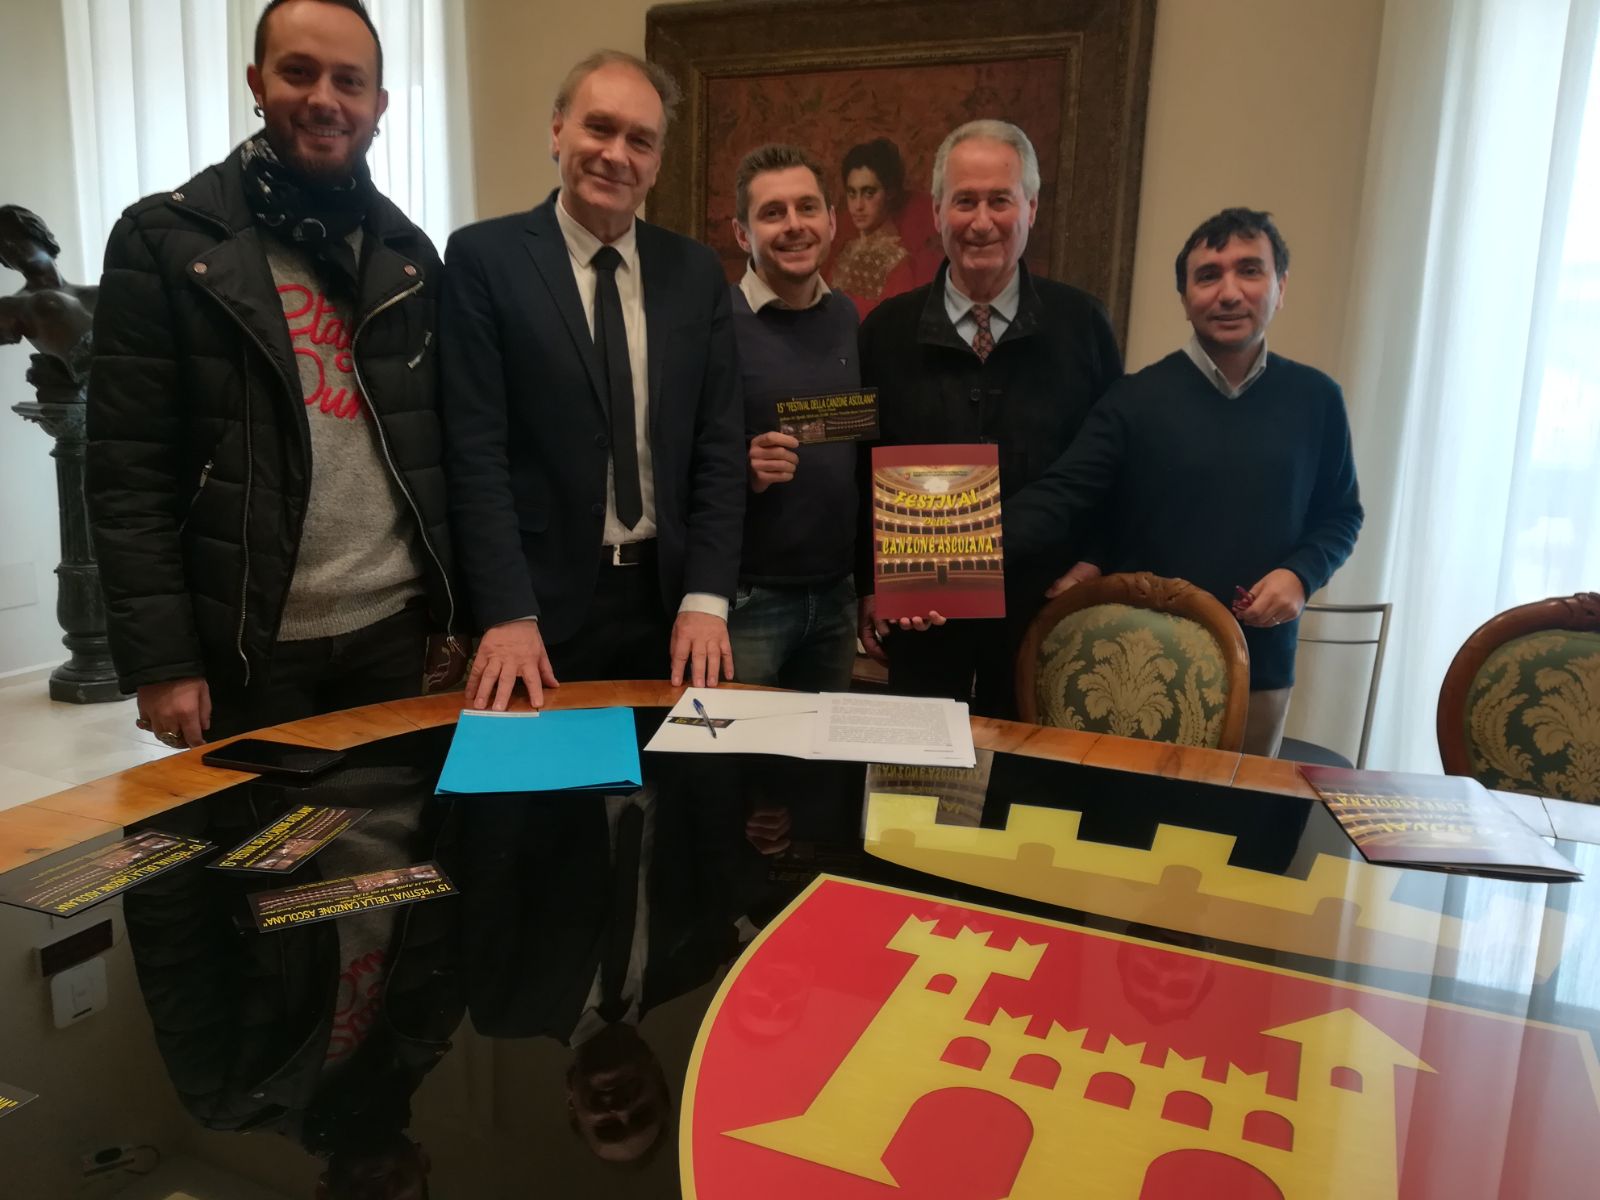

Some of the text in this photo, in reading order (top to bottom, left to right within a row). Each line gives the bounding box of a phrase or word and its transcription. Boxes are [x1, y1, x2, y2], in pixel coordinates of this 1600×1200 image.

[810, 399, 826, 410] DELLA
[826, 396, 848, 408] CANZONE
[895, 489, 979, 508] FESTIVAL
[882, 535, 993, 554] CANZONE ASCOLANA
[388, 888, 435, 901] "FESTIVAL
[434, 883, 451, 893] 15°
[318, 899, 361, 916] CANZONE
[358, 895, 390, 908] DELLA
[263, 909, 317, 927] ASCOLANA"
